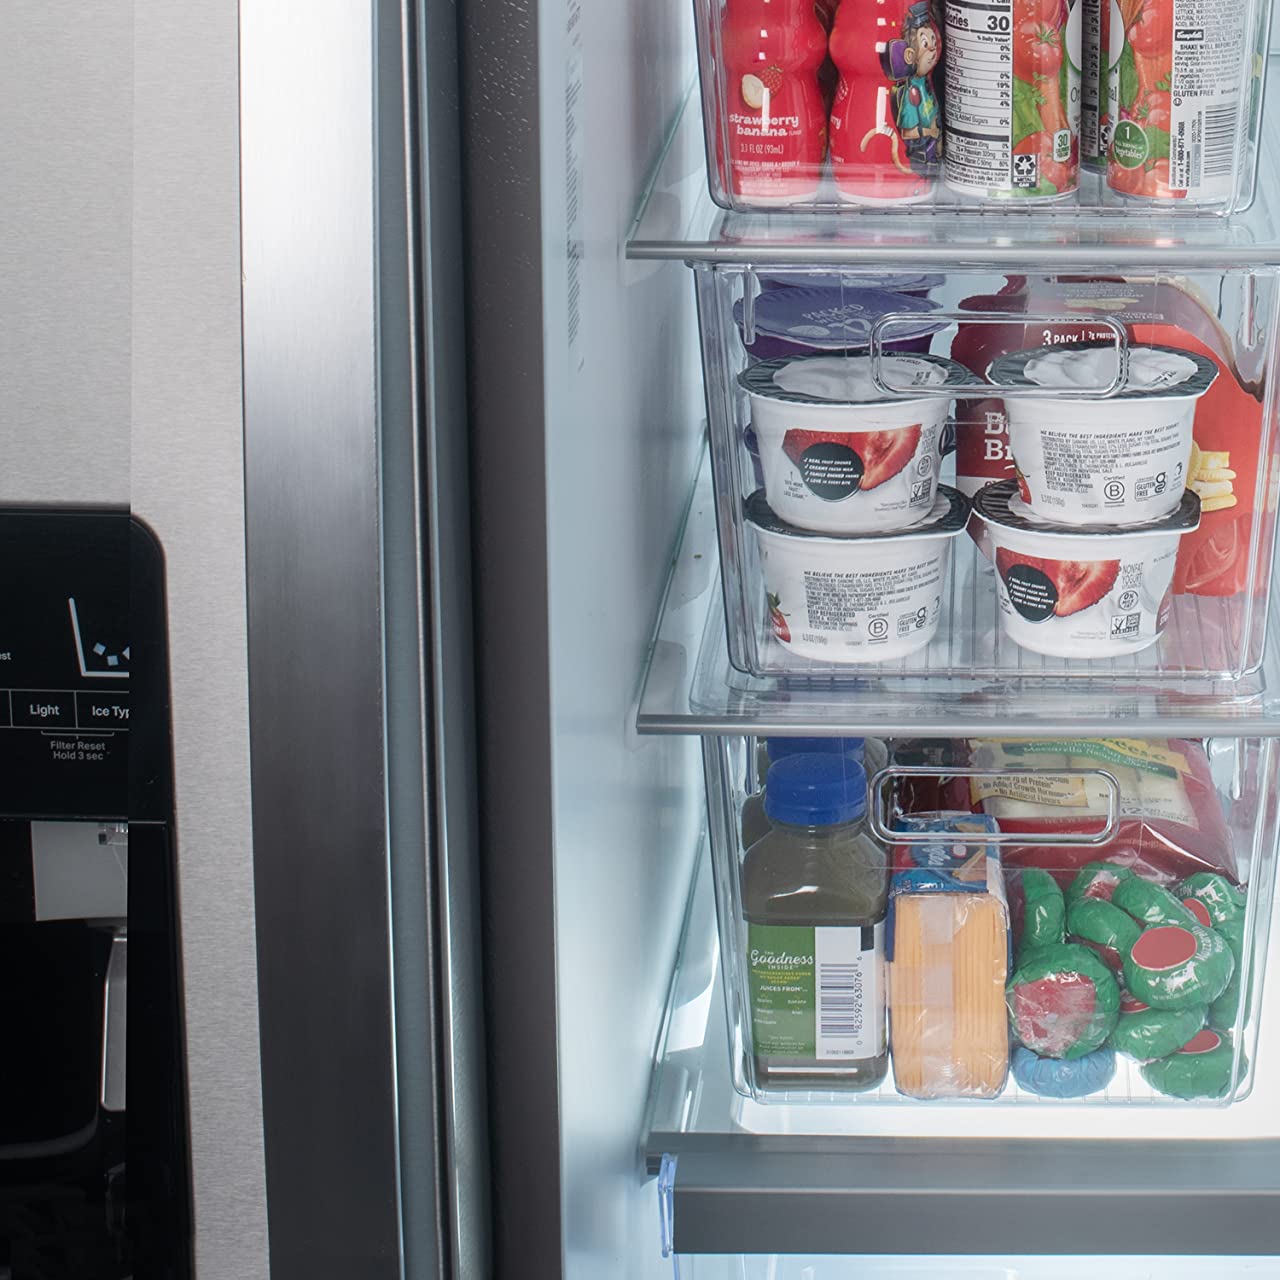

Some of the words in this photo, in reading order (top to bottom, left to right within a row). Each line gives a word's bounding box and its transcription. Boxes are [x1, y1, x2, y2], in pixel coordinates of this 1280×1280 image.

[987, 15, 1010, 31] 30
[972, 115, 988, 125] Sugars
[736, 125, 788, 136] banana
[1125, 126, 1130, 139] 1
[1058, 134, 1068, 146] 30
[749, 144, 756, 153] FL
[756, 144, 763, 154] OZ
[763, 144, 784, 154] (93mL)
[803, 304, 864, 321] PACKED
[1043, 330, 1051, 345] 3
[1054, 335, 1078, 344] PACK
[1109, 484, 1120, 497] B
[1137, 482, 1155, 490] GLUTEN
[1122, 562, 1144, 573] NONFAT
[1122, 573, 1142, 584] YOGURT
[820, 610, 855, 618] REFRIGERATED
[900, 617, 917, 625] GLUTEN
[873, 621, 884, 634] B
[29, 704, 60, 717] Light
[92, 706, 110, 716] Ice
[50, 741, 75, 750] Filter
[77, 741, 106, 751] Reset
[53, 751, 76, 760] Hold
[78, 751, 85, 760] 3
[993, 781, 1012, 790] Added
[1014, 783, 1036, 793] Growth
[1009, 790, 1036, 801] Artificial
[1037, 794, 1061, 805] Flavors
[751, 949, 813, 966] Goodness
